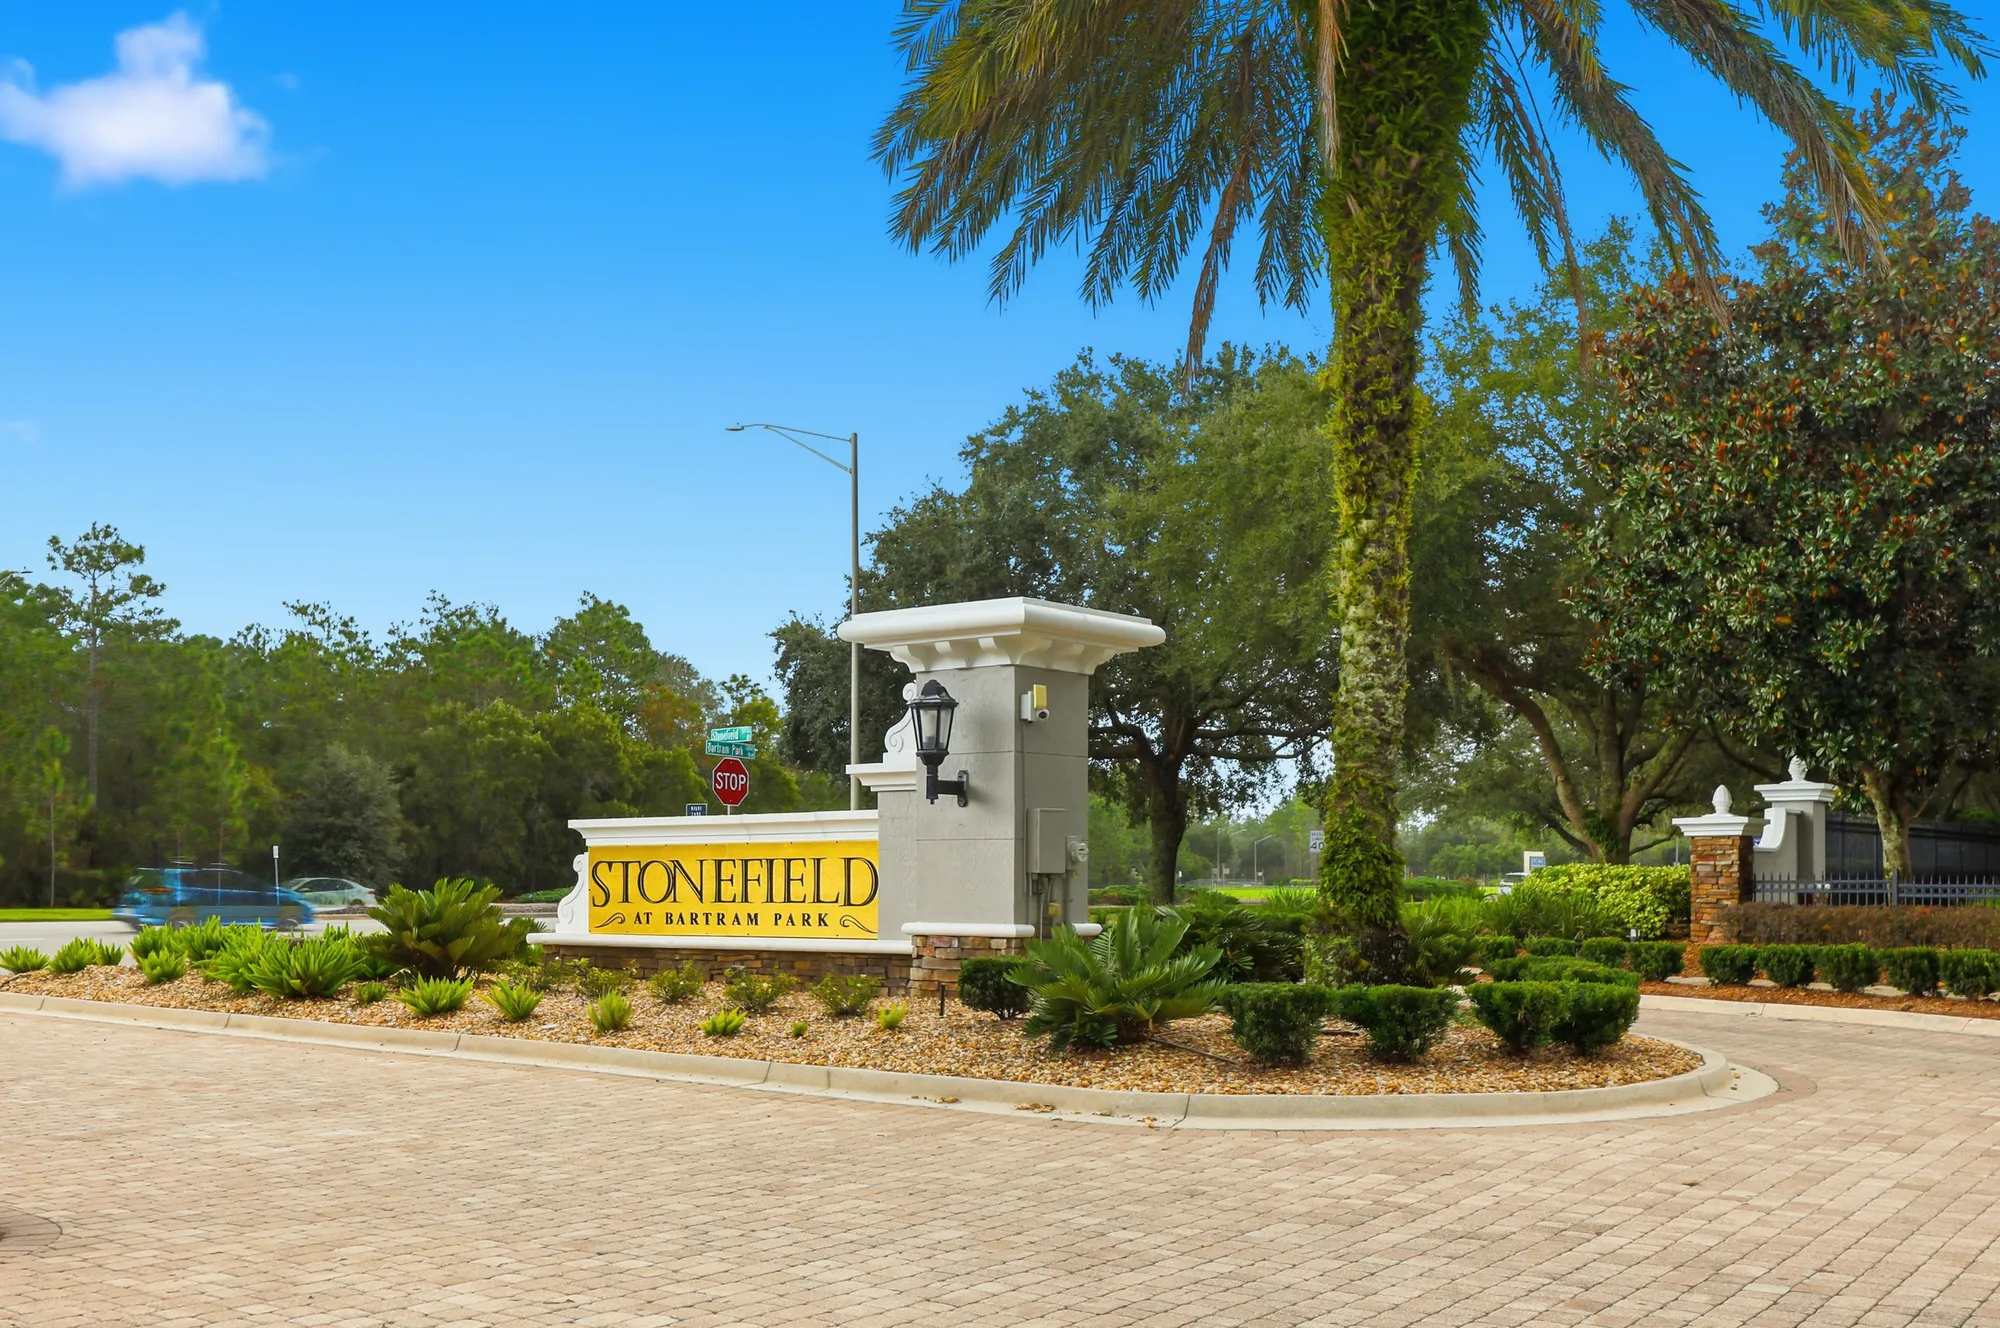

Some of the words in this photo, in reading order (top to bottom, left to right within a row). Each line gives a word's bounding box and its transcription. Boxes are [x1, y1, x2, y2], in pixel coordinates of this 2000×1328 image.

[707, 742, 729, 754] Bartram
[731, 744, 743, 755] Park
[715, 772, 746, 791] STOP
[1310, 842, 1324, 850] 40
[591, 857, 880, 907] STONEFIELD
[633, 911, 653, 925] AT
[665, 911, 760, 927] BARTRAM
[774, 911, 830, 928] PARK
